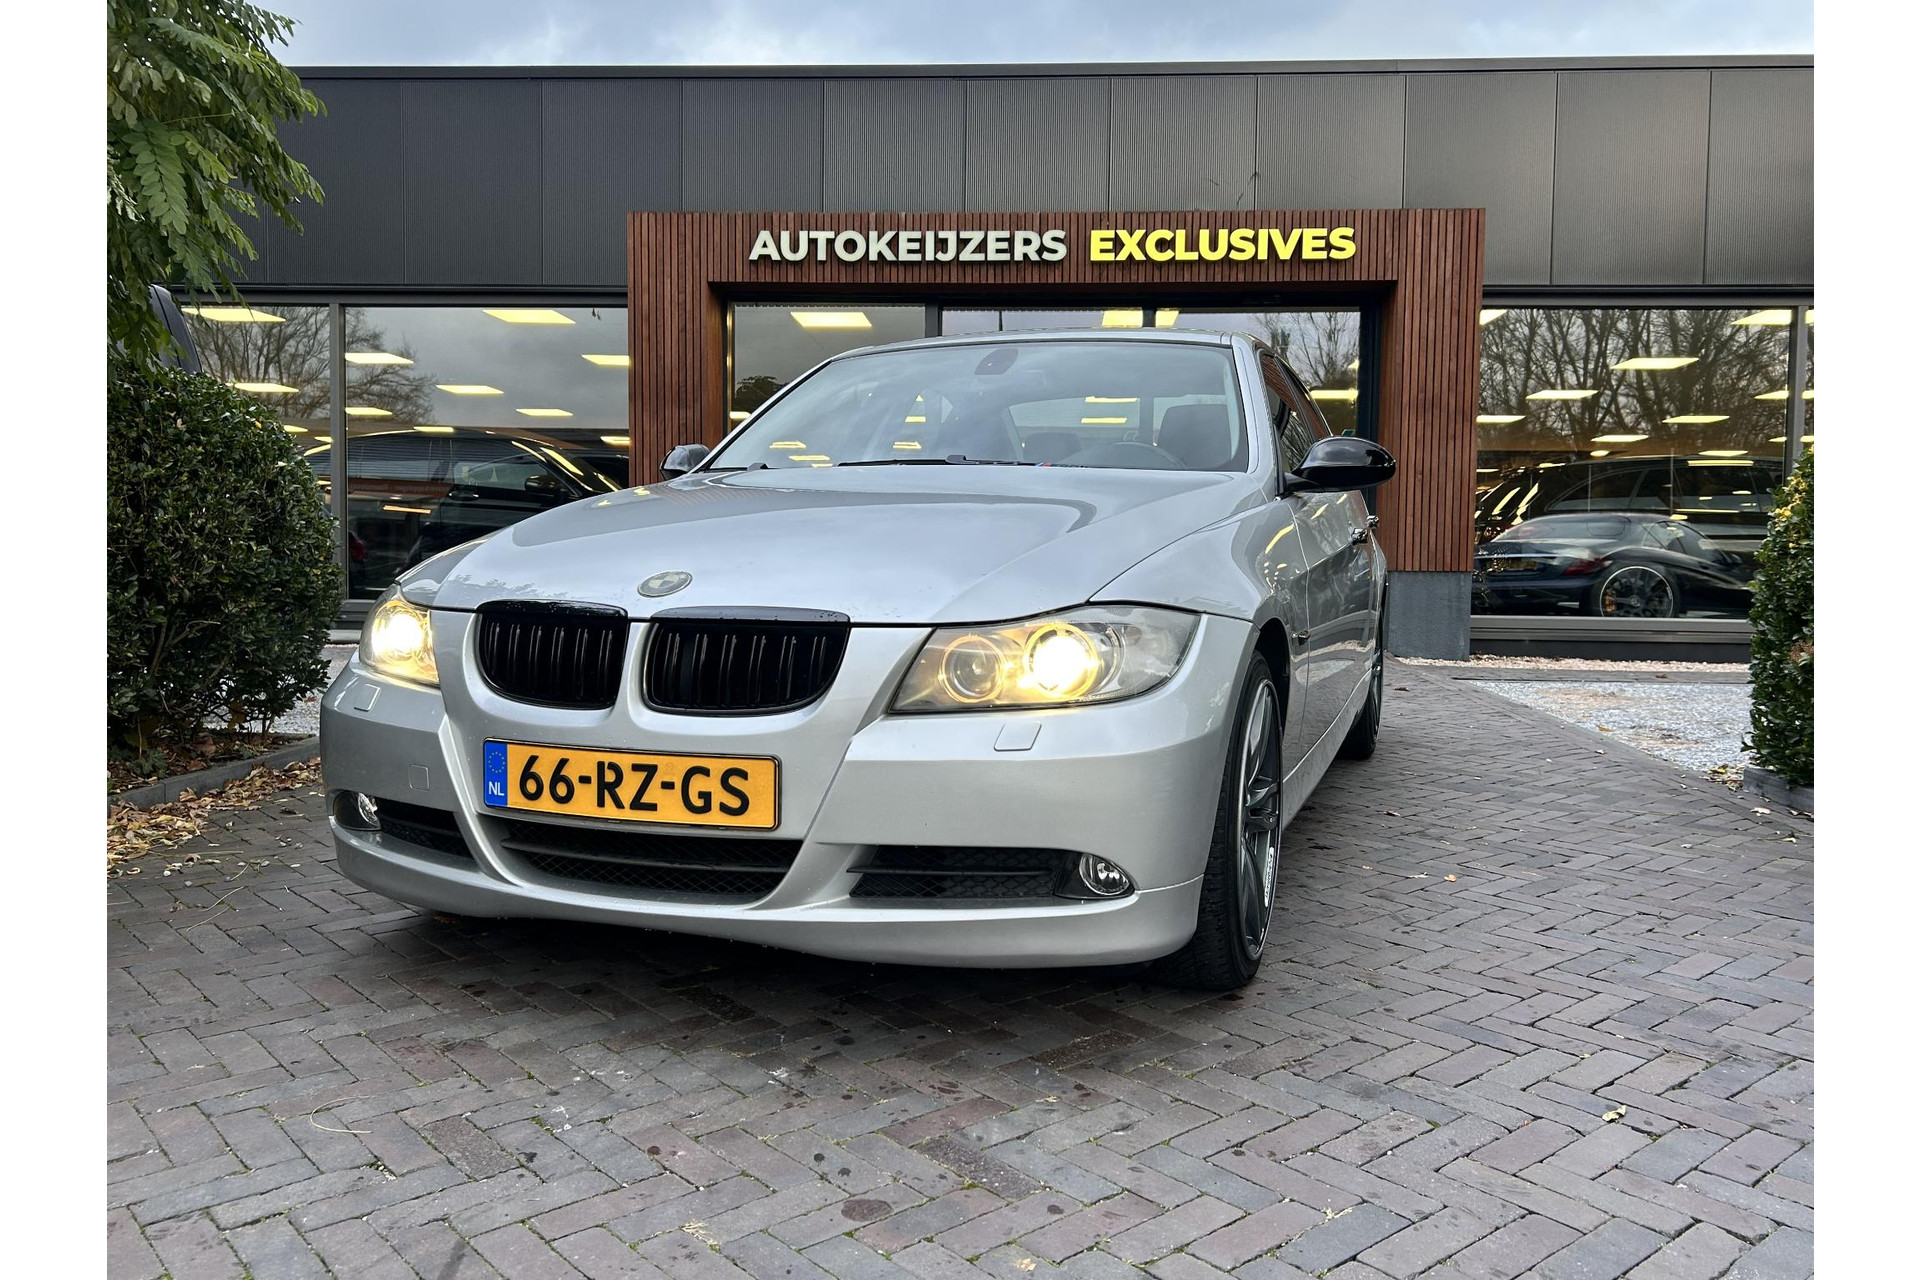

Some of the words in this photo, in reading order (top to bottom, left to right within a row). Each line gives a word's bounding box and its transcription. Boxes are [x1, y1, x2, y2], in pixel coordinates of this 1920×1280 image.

[749, 229, 1068, 262] AUTOKEIJZERS
[1090, 226, 1357, 262] EXCLUSIVES
[488, 781, 505, 797] NL
[519, 755, 750, 816] 66-RZ-GS
